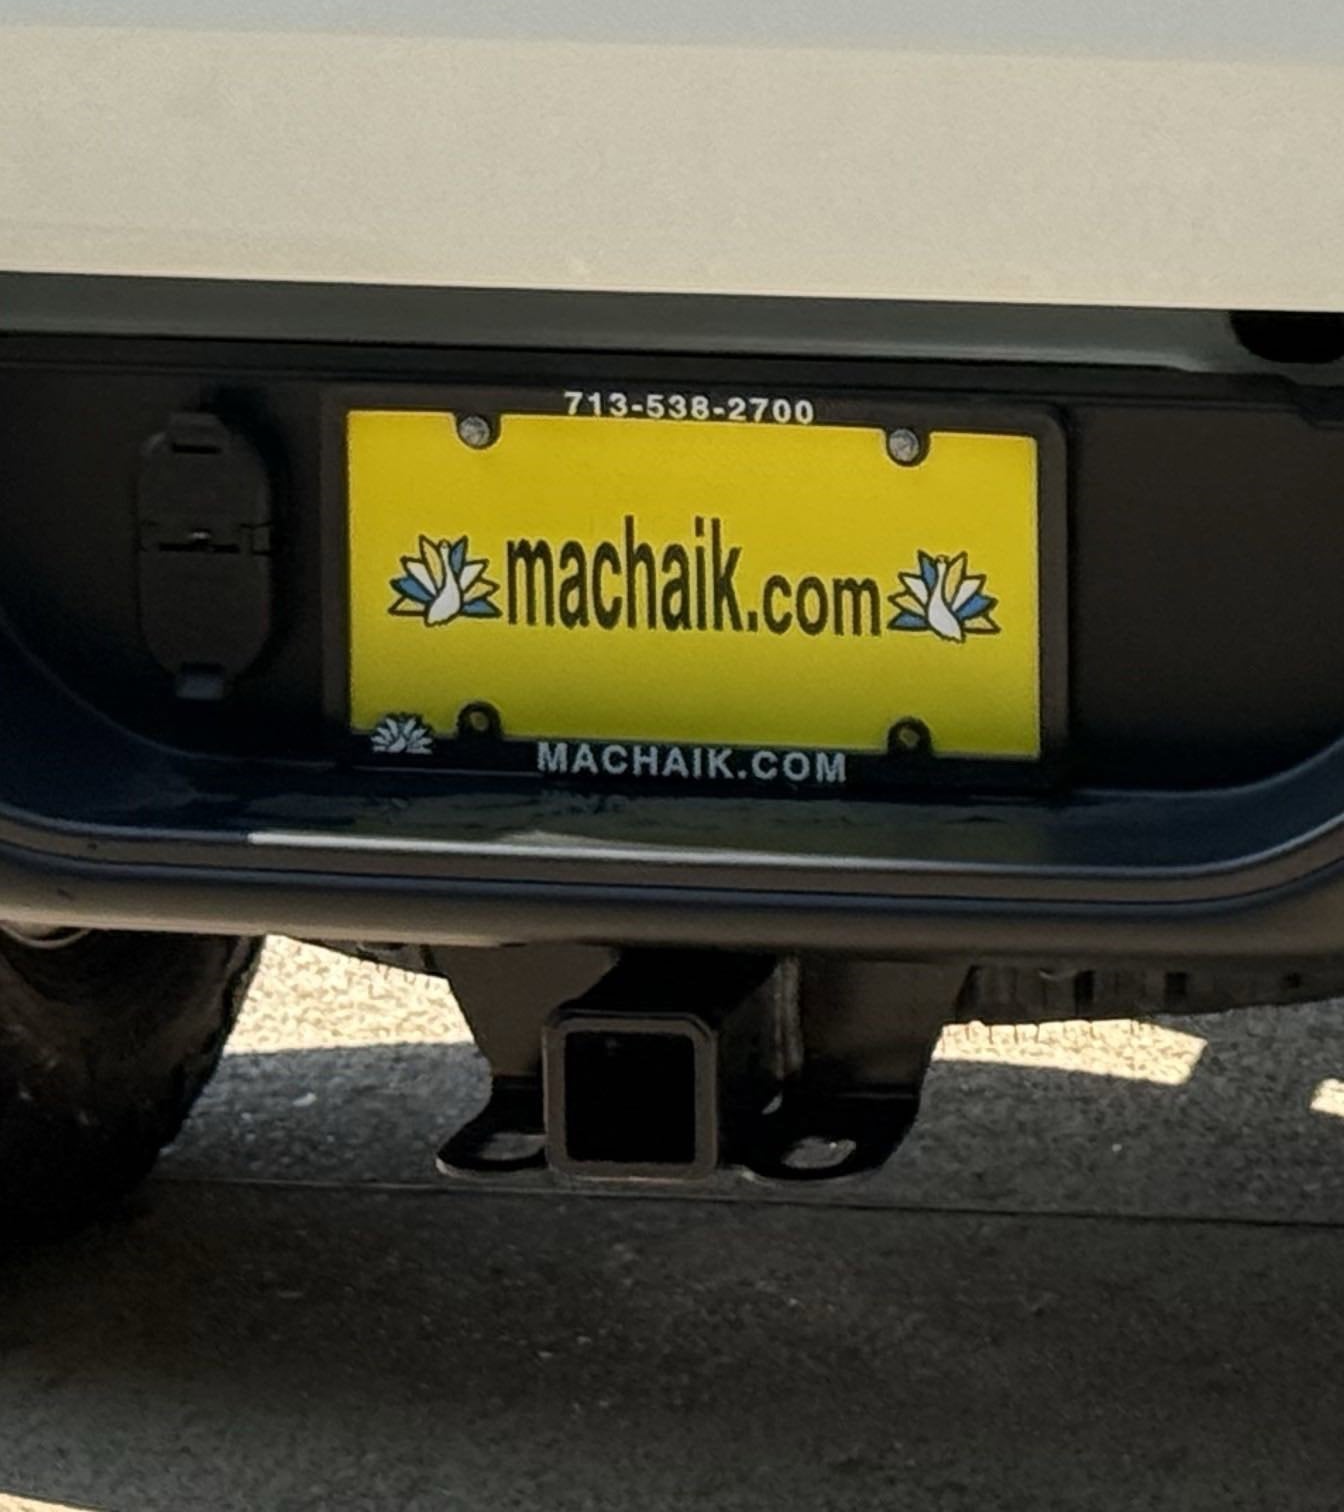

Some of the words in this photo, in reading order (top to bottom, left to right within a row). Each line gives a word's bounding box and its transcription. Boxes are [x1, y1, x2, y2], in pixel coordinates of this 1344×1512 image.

[564, 391, 814, 424] 713-538-2700
[505, 515, 882, 637] machaik.com
[537, 741, 847, 783] MACHAIK.COM
